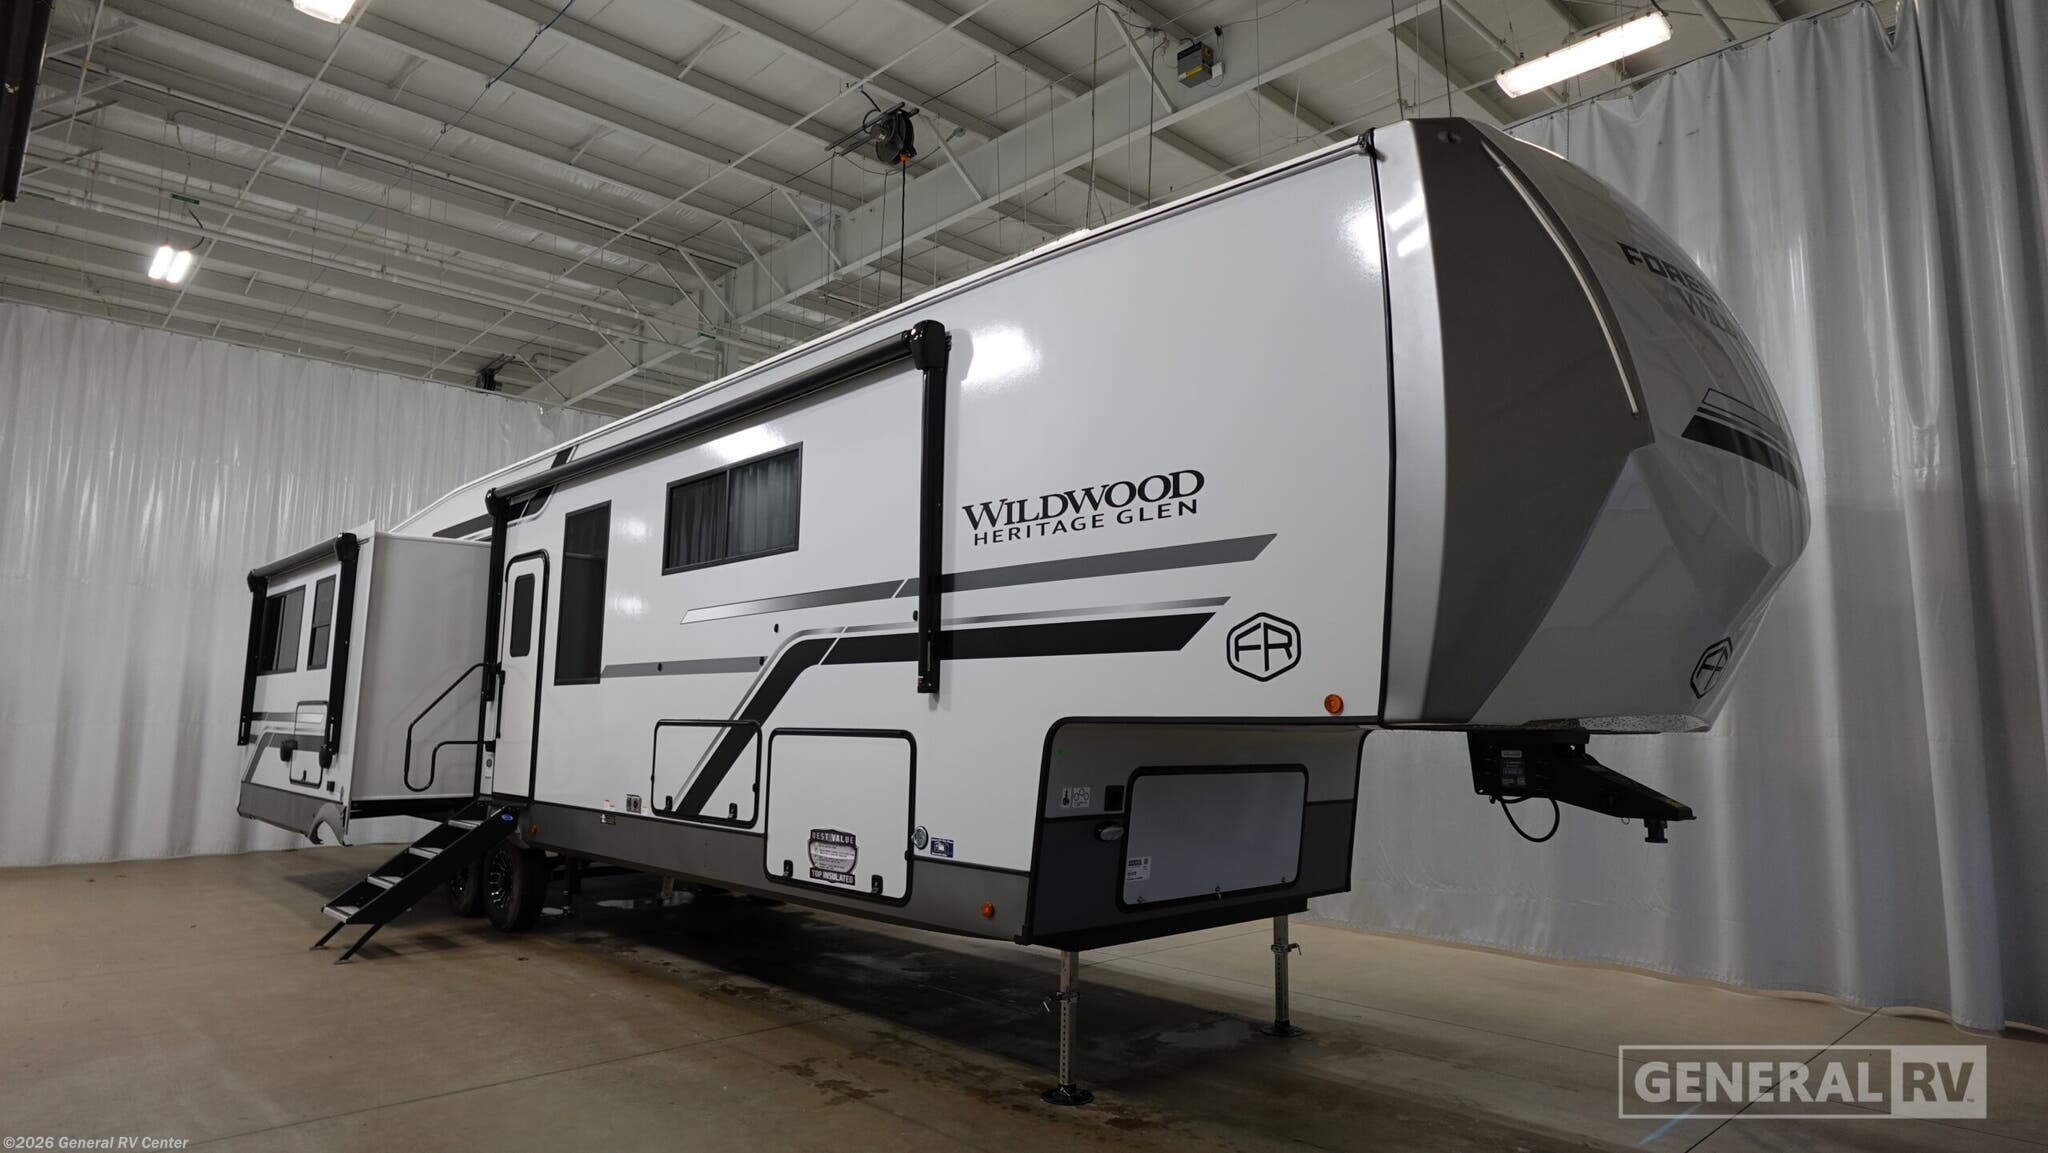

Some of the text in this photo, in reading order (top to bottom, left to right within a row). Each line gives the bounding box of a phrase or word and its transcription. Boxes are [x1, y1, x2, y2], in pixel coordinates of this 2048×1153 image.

[1616, 241, 1720, 307] FORES
[962, 469, 1205, 531] WILDWOOD
[974, 498, 1198, 546] HERITAGE GLEN
[1233, 620, 1294, 673] FR
[831, 834, 855, 845] VALUE
